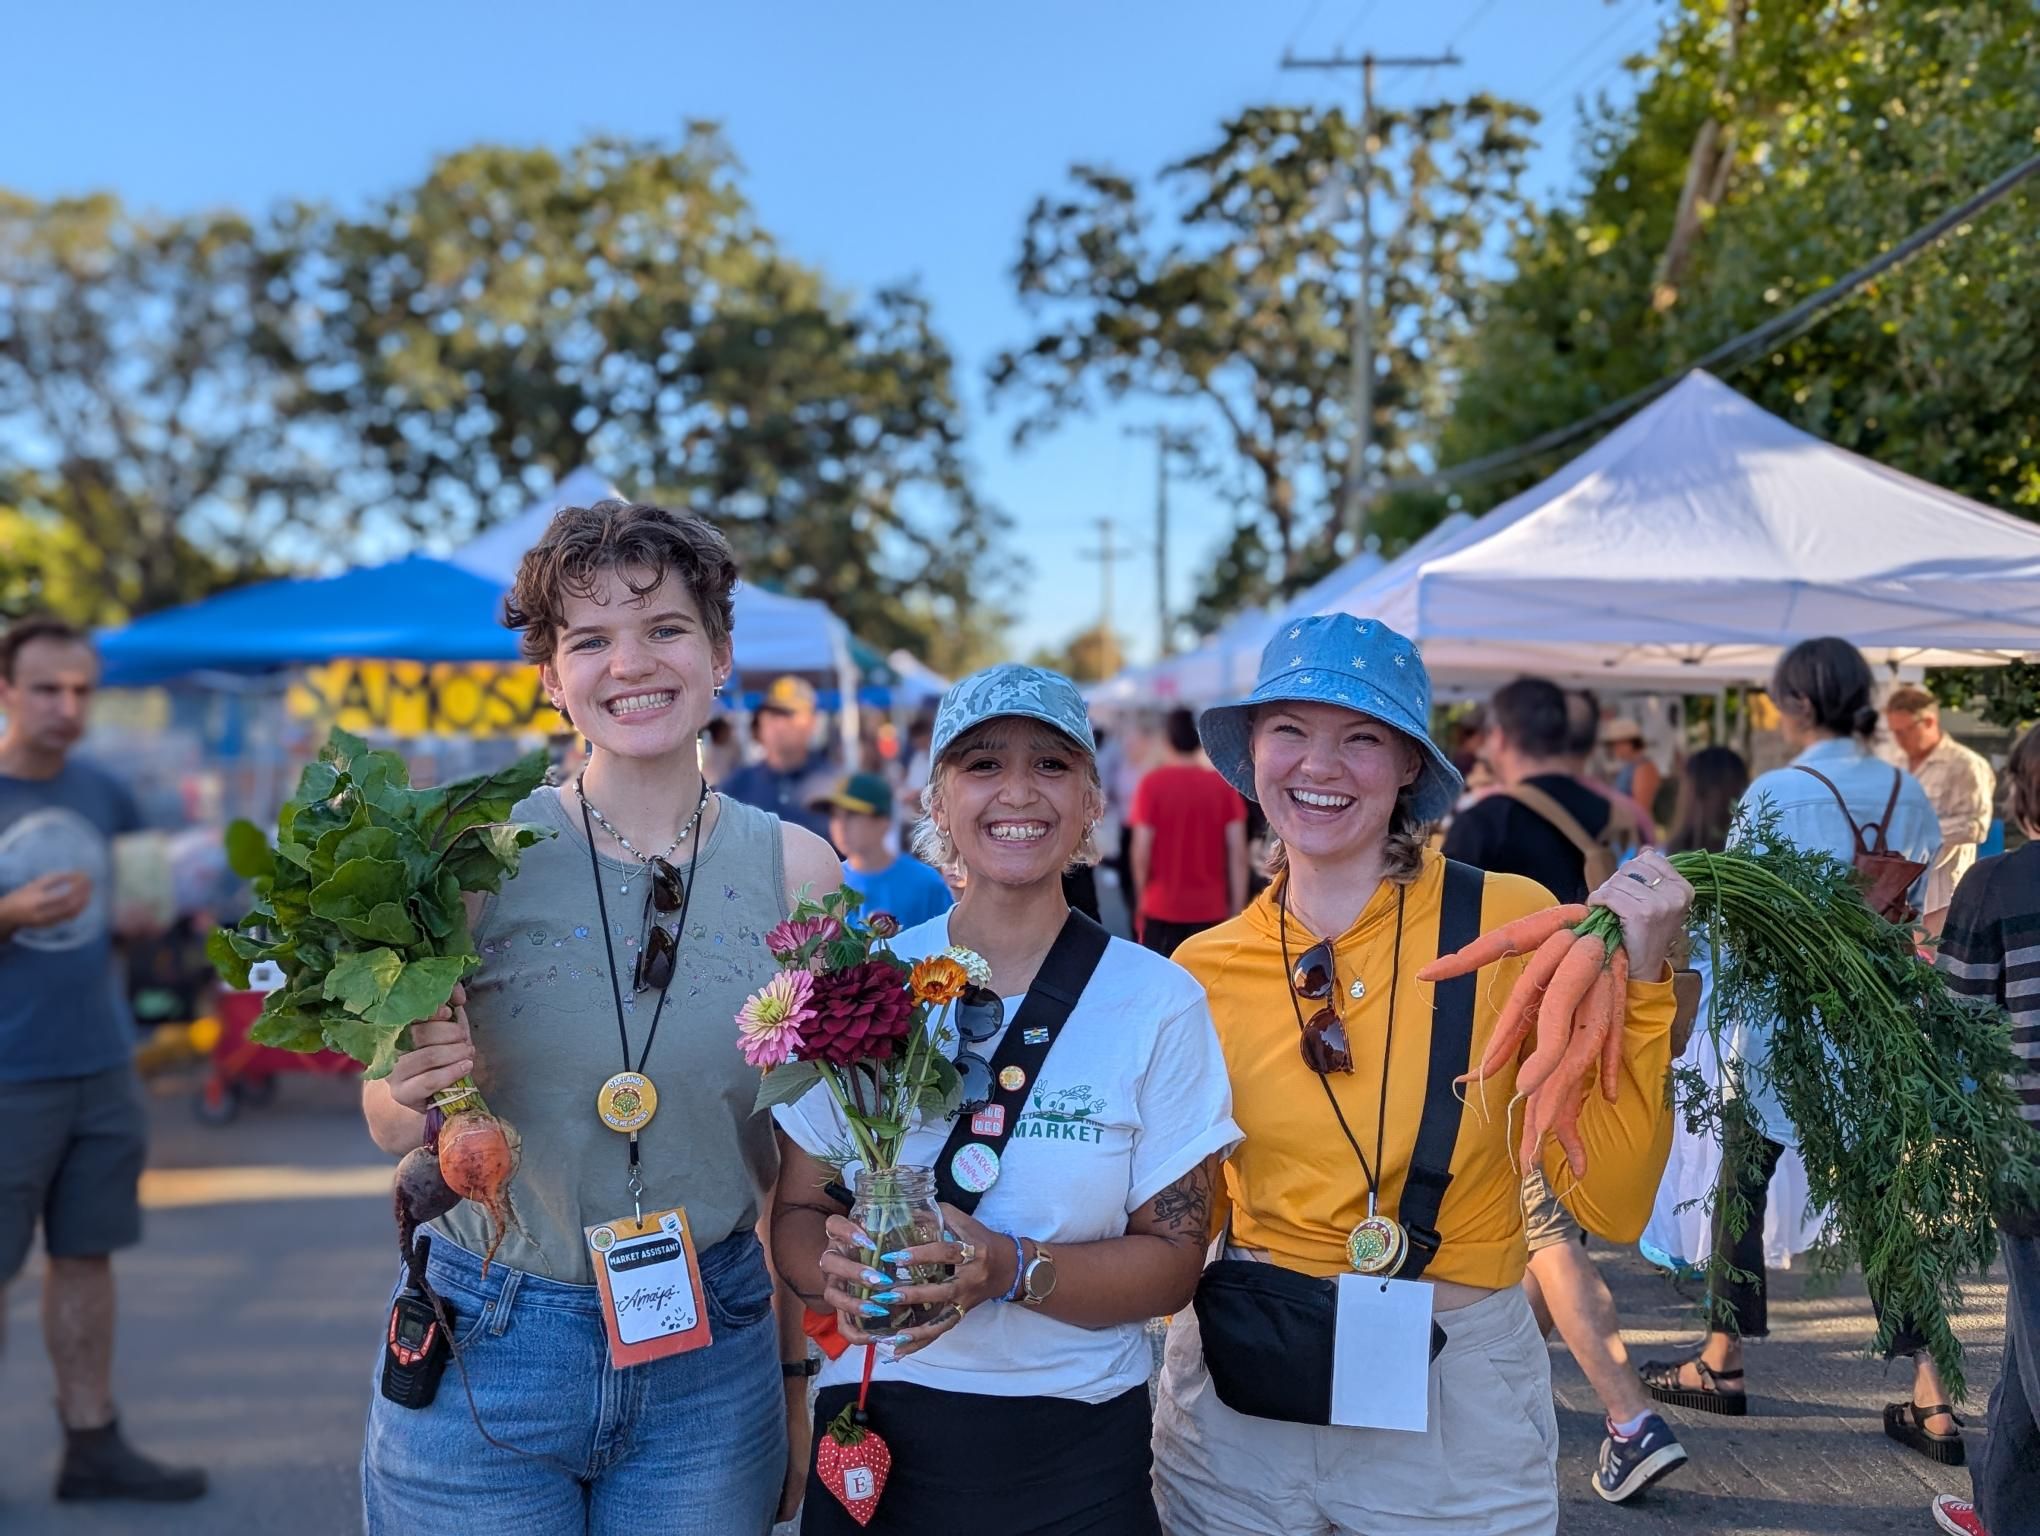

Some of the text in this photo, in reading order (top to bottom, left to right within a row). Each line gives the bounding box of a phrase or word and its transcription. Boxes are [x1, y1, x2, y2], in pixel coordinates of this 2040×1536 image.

[608, 1075, 645, 1089] OAKLANDS
[604, 1112, 619, 1126] MADE
[619, 1119, 629, 1127] ME
[1010, 1121, 1104, 1145] MARKET
[967, 1145, 998, 1178] MARKET
[609, 1242, 680, 1266] MARKET ASSISTANT
[618, 1287, 676, 1312] Amaya
